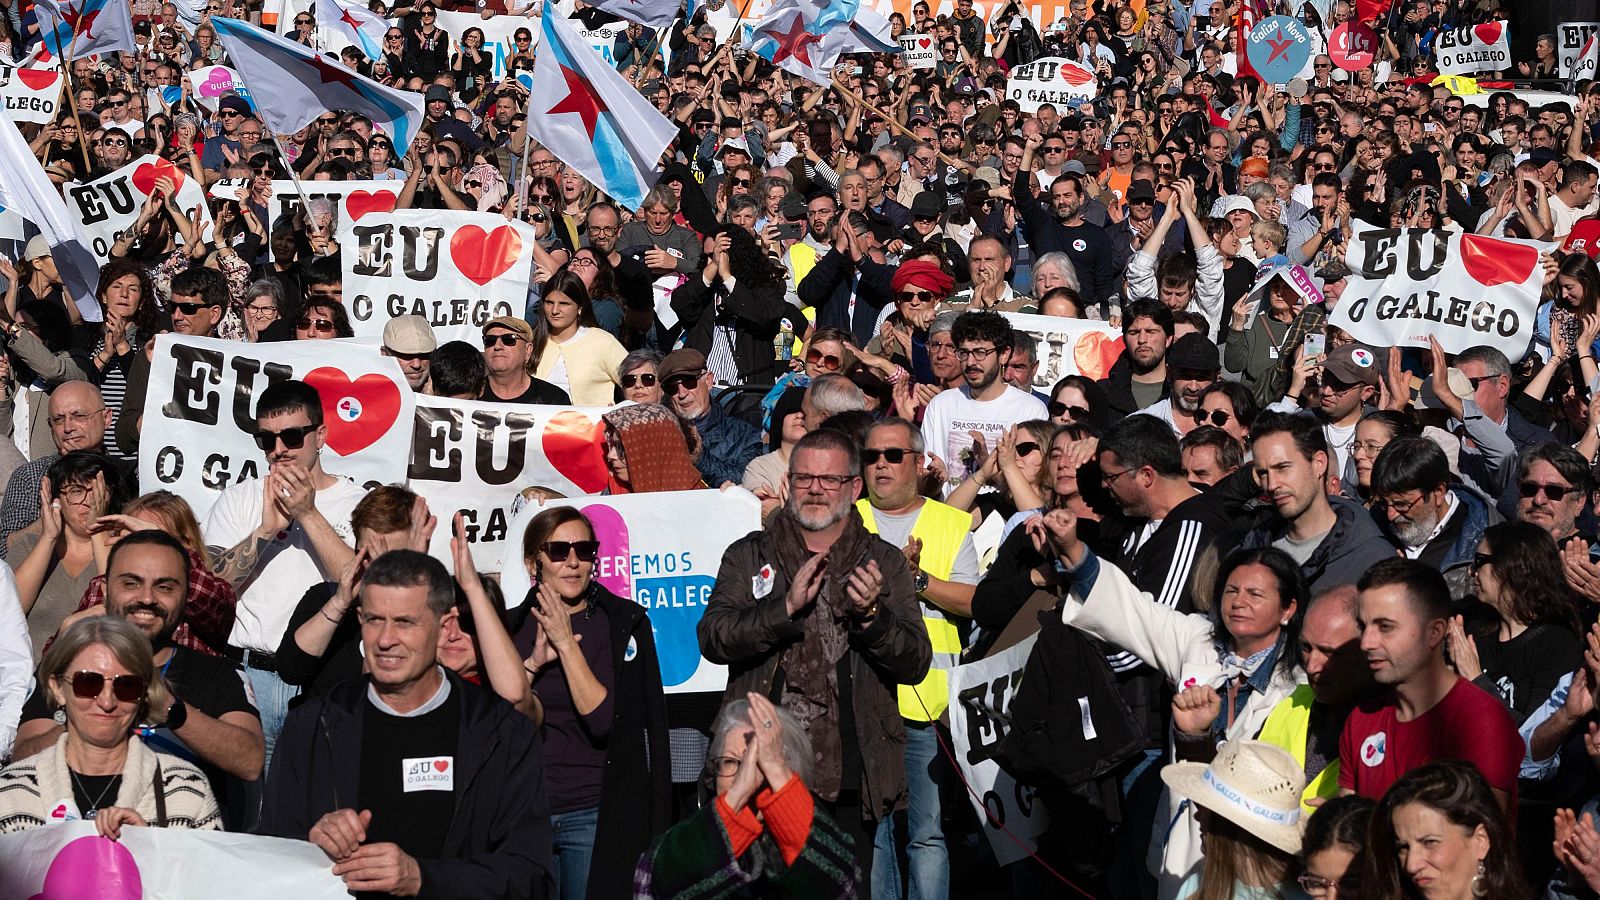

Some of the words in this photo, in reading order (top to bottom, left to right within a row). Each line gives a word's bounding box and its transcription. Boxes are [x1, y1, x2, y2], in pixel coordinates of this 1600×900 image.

[1250, 20, 1279, 43] Galiza
[1285, 21, 1306, 44] Nova
[1338, 31, 1369, 50] CIG
[1439, 25, 1472, 49] EU
[900, 39, 917, 51] EU
[1442, 55, 1451, 67] O
[1455, 50, 1505, 64] GALEGO
[1014, 62, 1059, 82] EU
[5, 96, 54, 114] LEGO
[1013, 89, 1022, 100] O
[70, 175, 135, 226] EU
[353, 224, 445, 282] EU
[1359, 228, 1454, 281] EU
[353, 294, 373, 321] O
[387, 294, 513, 327] GALEGO
[1348, 297, 1369, 323] O
[1375, 290, 1520, 338] GALEGO
[1025, 330, 1068, 387] U
[162, 343, 293, 434] EU
[952, 420, 985, 431] BRASSICA
[985, 423, 1004, 432] RAPA
[407, 405, 535, 485] EU
[155, 445, 184, 483] O
[600, 552, 692, 578] EREMOS
[638, 584, 712, 609] GALEG
[408, 761, 432, 775] EU
[415, 774, 449, 783] GALEGO
[983, 790, 1005, 830] O
[1215, 782, 1242, 804] GALIZA
[1253, 806, 1284, 821] GALIZA
